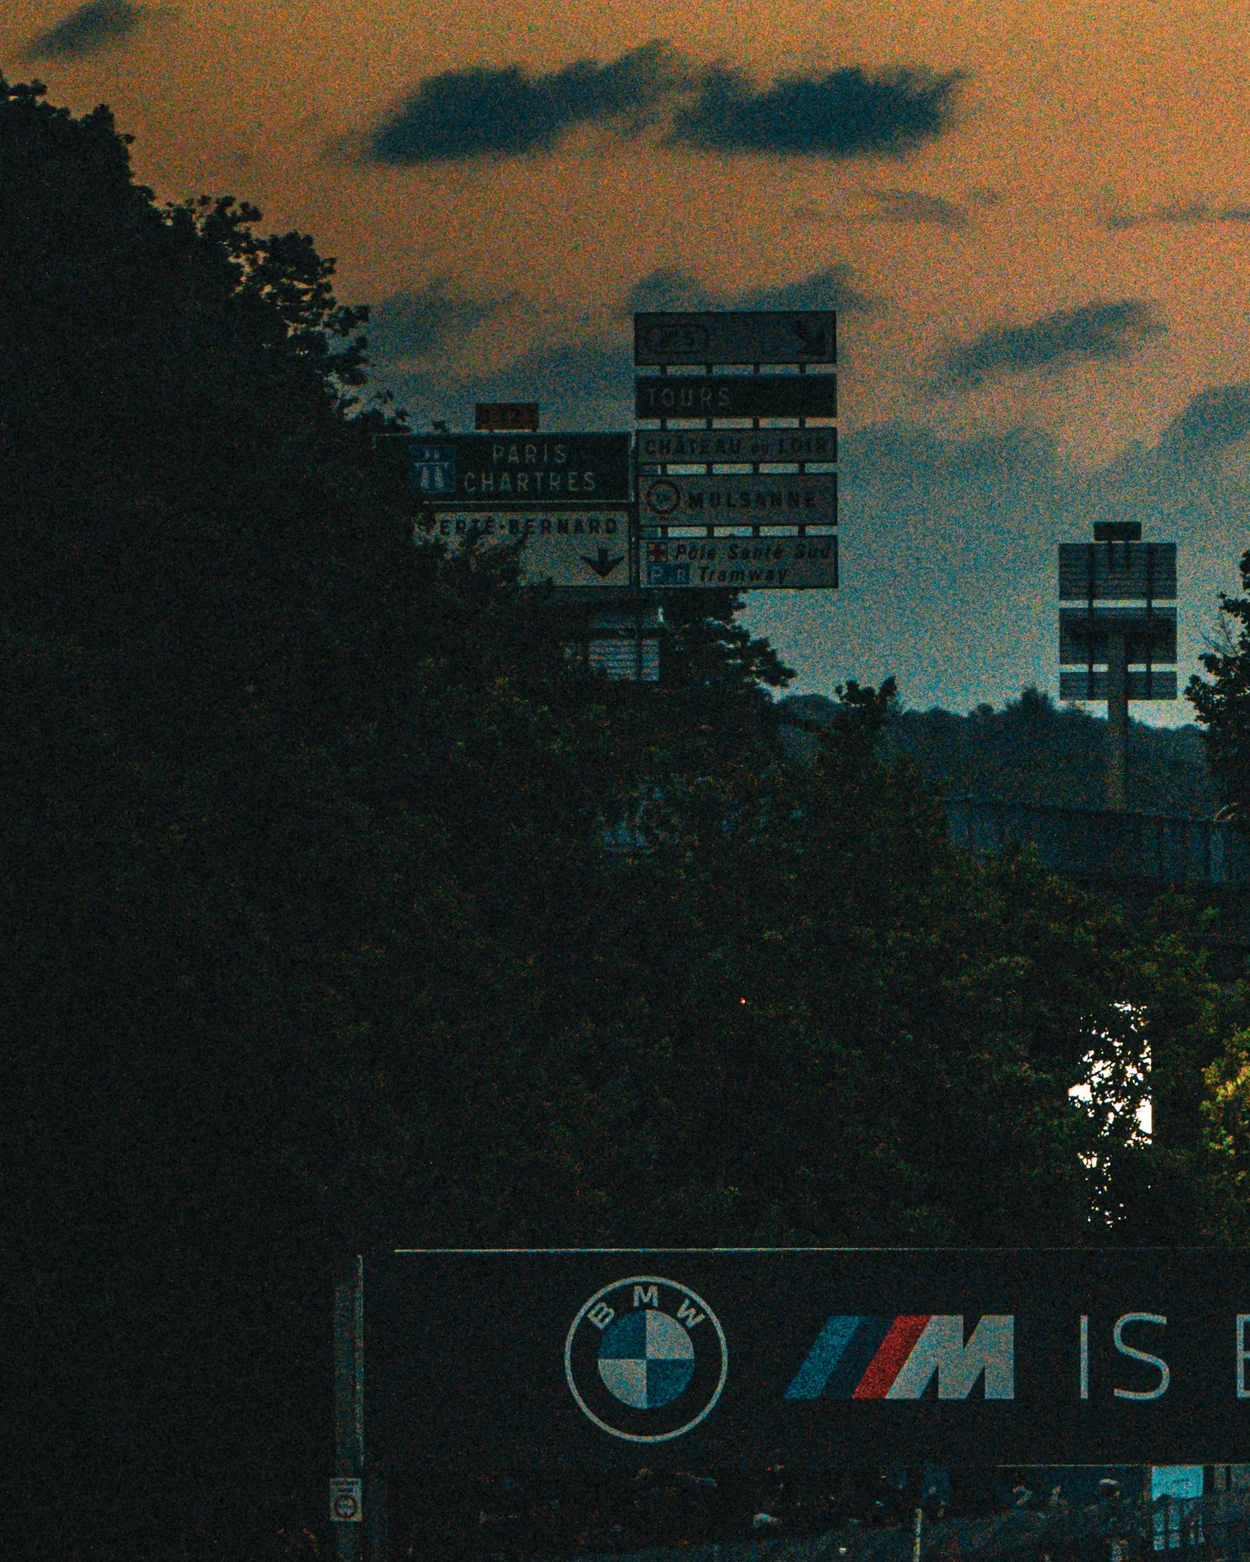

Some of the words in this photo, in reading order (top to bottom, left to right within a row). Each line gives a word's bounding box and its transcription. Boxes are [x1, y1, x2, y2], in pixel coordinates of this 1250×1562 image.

[647, 387, 730, 409] TOURS
[492, 443, 567, 464] PARIS
[777, 437, 827, 454] LOIR
[463, 471, 596, 493] CHARTRES
[687, 490, 817, 508] MULSANNE
[727, 542, 784, 560] Santé
[793, 541, 832, 560] Sud
[698, 565, 788, 584] Tramway
[587, 1285, 706, 1331] BMW
[1080, 1312, 1170, 1400] IS
